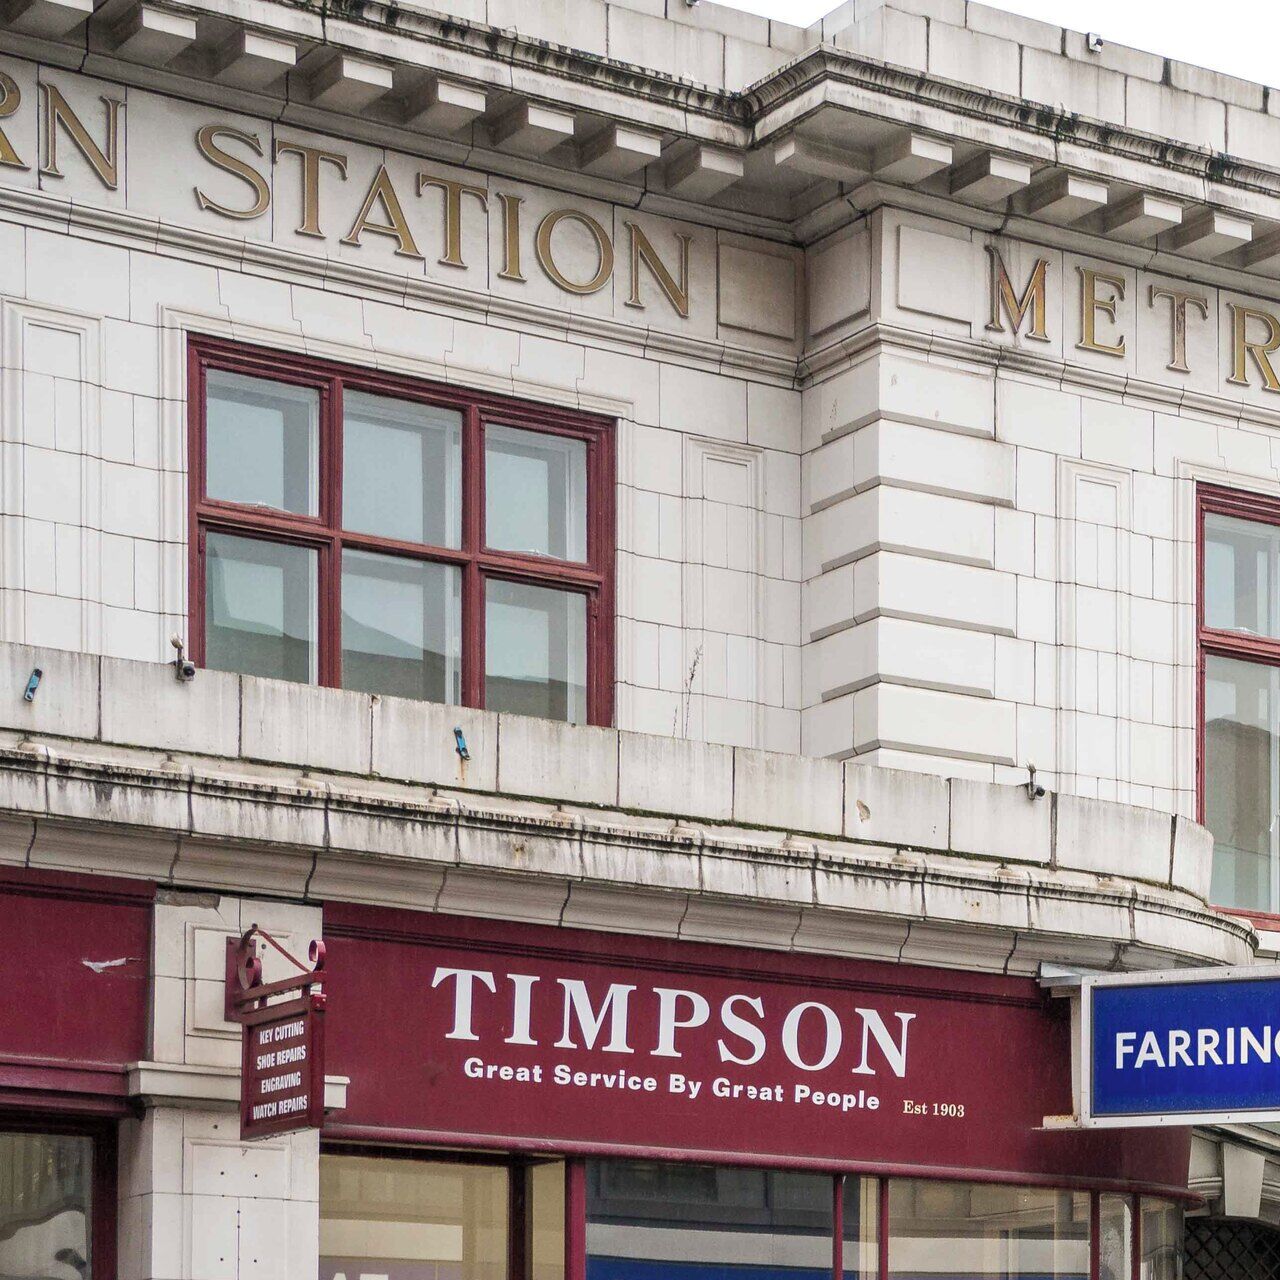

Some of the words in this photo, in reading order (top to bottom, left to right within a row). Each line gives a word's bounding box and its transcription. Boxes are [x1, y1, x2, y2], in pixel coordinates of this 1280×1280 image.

[195, 124, 693, 319] STATION
[260, 1028, 272, 1044] KEY
[275, 1021, 303, 1041] CUTTING
[431, 967, 917, 1078] TIMPSON
[257, 1053, 275, 1070] SHOE
[277, 1045, 306, 1065] REPAIRS
[261, 1072, 300, 1093] ENGRAVING
[464, 1058, 542, 1083] Great
[554, 1065, 657, 1092] Service
[669, 1074, 702, 1099] By
[713, 1078, 784, 1102] Great
[795, 1085, 880, 1112] People
[253, 1102, 276, 1120] WATCH
[279, 1095, 307, 1114] REPAIRS
[903, 1100, 928, 1116] Est
[932, 1103, 965, 1117] 1903
